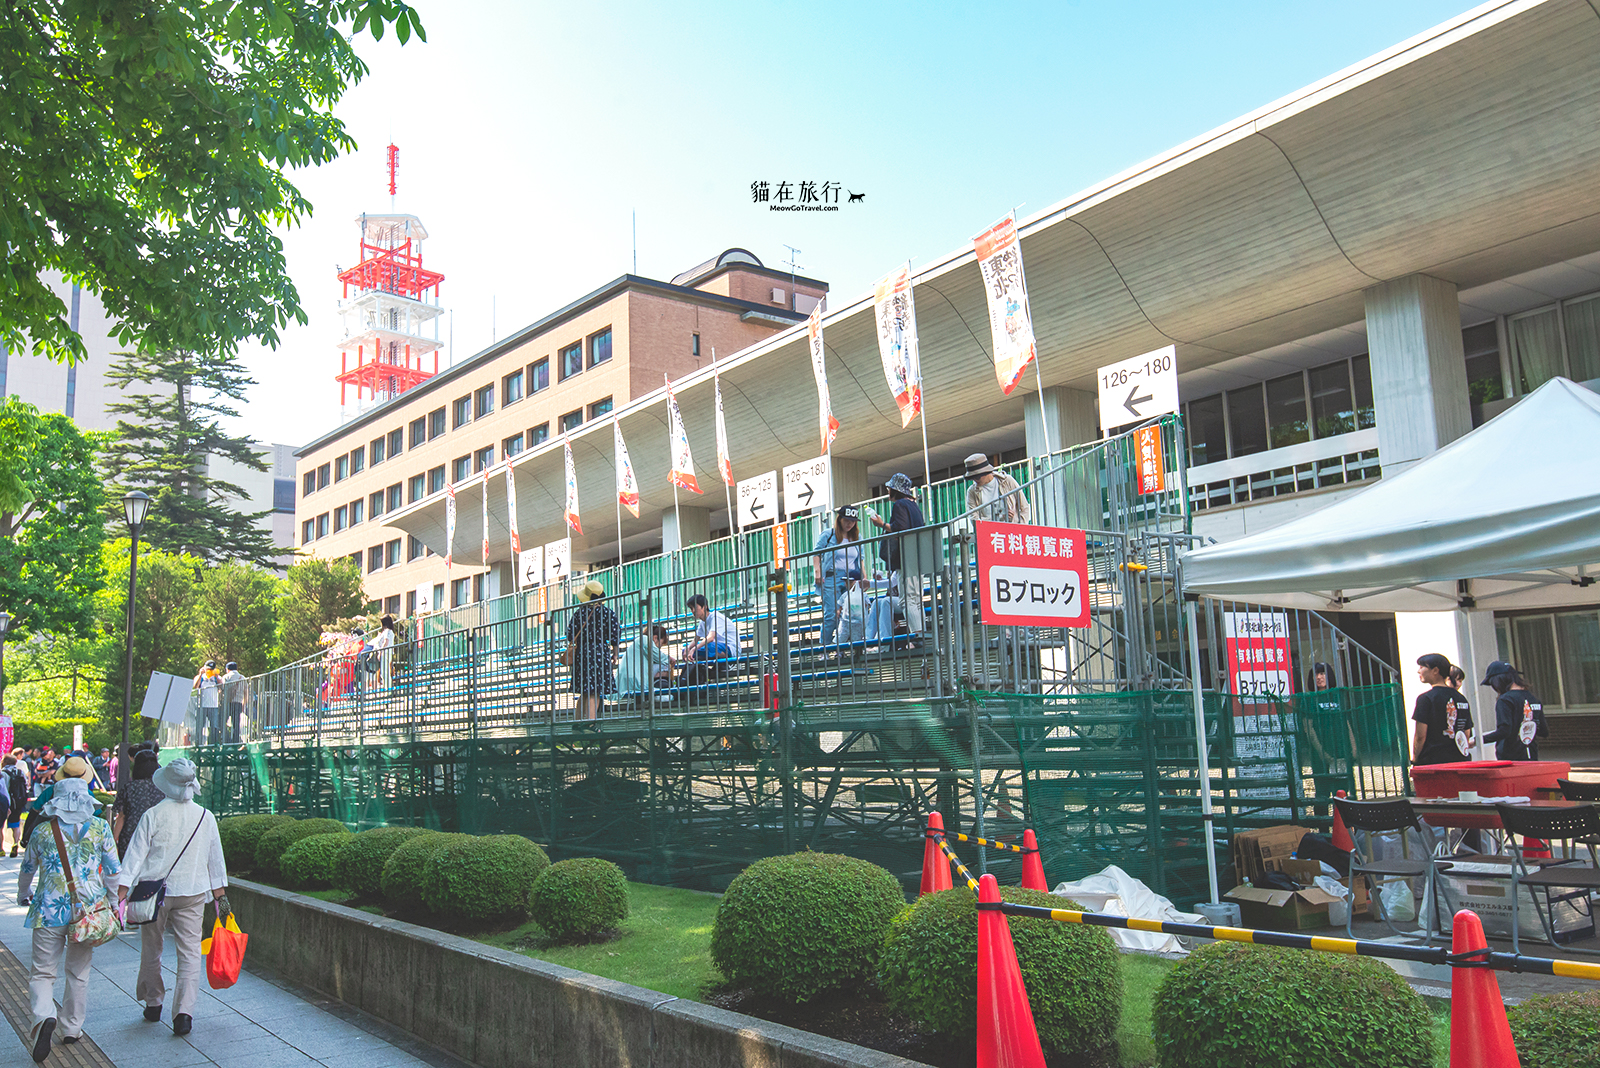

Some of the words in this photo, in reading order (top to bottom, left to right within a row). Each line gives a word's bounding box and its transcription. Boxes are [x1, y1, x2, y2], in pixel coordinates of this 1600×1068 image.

[990, 531, 1074, 558] 有料観覧席
[996, 578, 1075, 605] Bブロック
[1235, 648, 1284, 663] 有料観覧席
[1240, 679, 1286, 696] Bブロック
